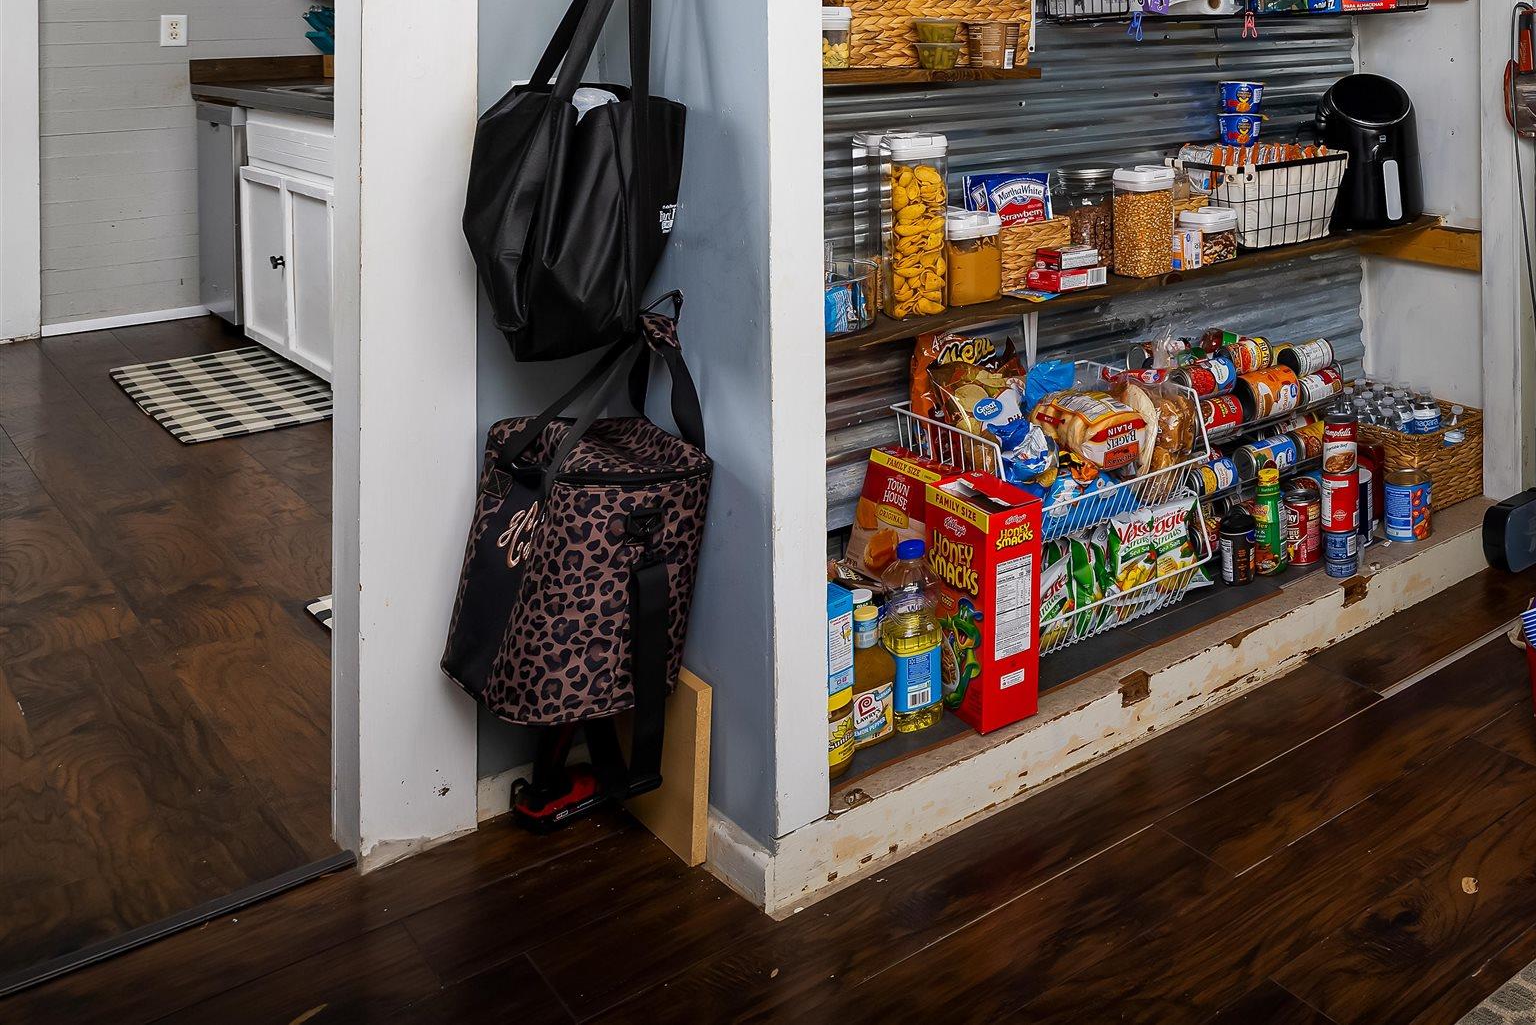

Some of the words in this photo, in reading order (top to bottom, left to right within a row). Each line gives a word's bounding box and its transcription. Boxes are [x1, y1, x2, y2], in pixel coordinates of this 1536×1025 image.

[1000, 209, 1044, 222] Strawberry
[976, 400, 997, 415] Great
[1106, 429, 1136, 450] BAGELS
[1107, 422, 1133, 436] PLAIN
[886, 457, 907, 472] FAMILY
[908, 466, 921, 478] SIZE
[887, 477, 911, 498] TOWN
[882, 489, 908, 511] HOUSE
[935, 493, 960, 512] FAMILY
[961, 506, 977, 523] SIZE
[878, 509, 904, 525] ORIGINAL
[995, 530, 1034, 551] SMACKS
[1000, 522, 1030, 540] HONEY
[933, 528, 974, 567] HONEY
[929, 548, 979, 596] SMACKS
[854, 727, 868, 737] EMON
